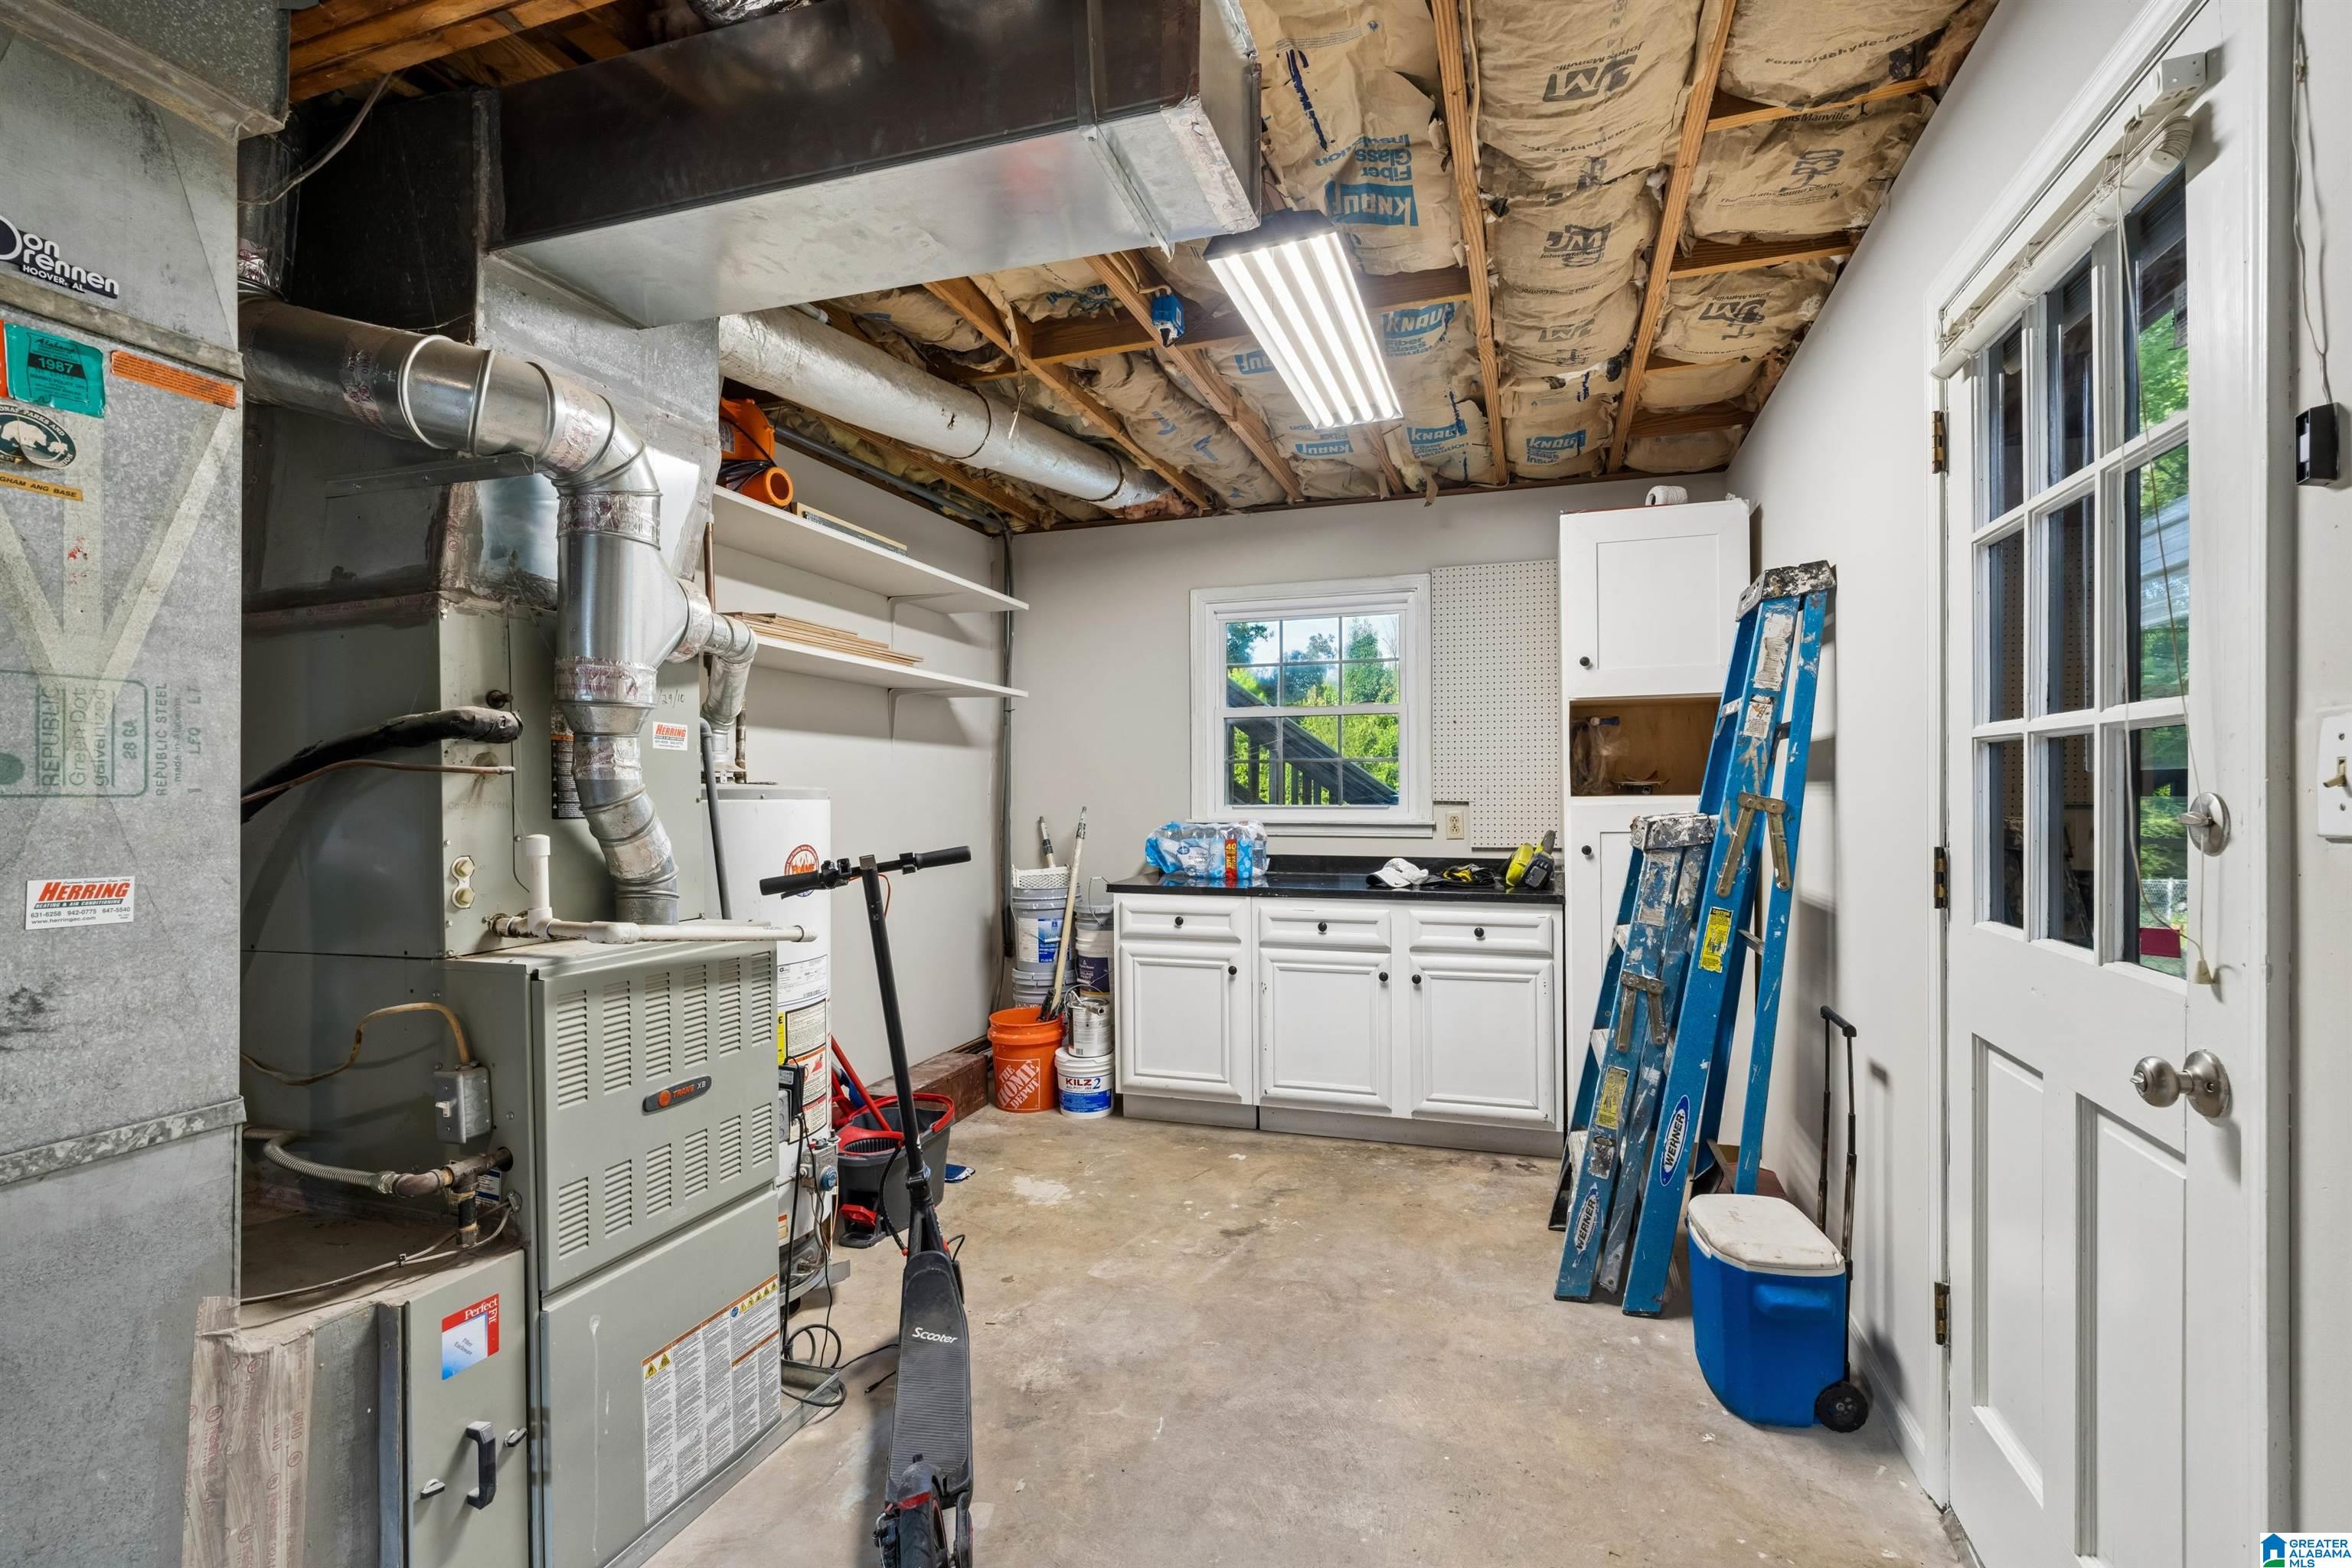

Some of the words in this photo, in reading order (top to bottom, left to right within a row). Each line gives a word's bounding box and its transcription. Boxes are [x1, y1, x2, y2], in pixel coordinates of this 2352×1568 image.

[1801, 111, 1850, 122] Manville
[1355, 149, 1412, 165] Glass
[1360, 166, 1412, 181] Fiber
[38, 357, 74, 374] 1987
[24, 410, 50, 424] PARKS
[50, 424, 66, 436] AND
[31, 483, 50, 492] ANG
[54, 488, 77, 498] BASE
[155, 682, 168, 724] STEEL
[41, 685, 60, 787] REPUBLIC
[656, 724, 687, 738] HERRING
[122, 742, 139, 760] 28
[155, 730, 168, 797] REPUBLIC
[38, 881, 130, 902] HERRING
[998, 1064, 1016, 1083] THE
[697, 1080, 707, 1089] XB
[998, 1060, 1040, 1109] HOME
[1066, 1078, 1092, 1086] KILZ
[1093, 1078, 1101, 1089] 2
[1010, 1078, 1040, 1109] DEPOT
[1664, 1112, 1685, 1167] WERNER
[1575, 1197, 1597, 1251] WERNER
[464, 1297, 498, 1321] Perfect
[911, 1326, 959, 1344] Scooter
